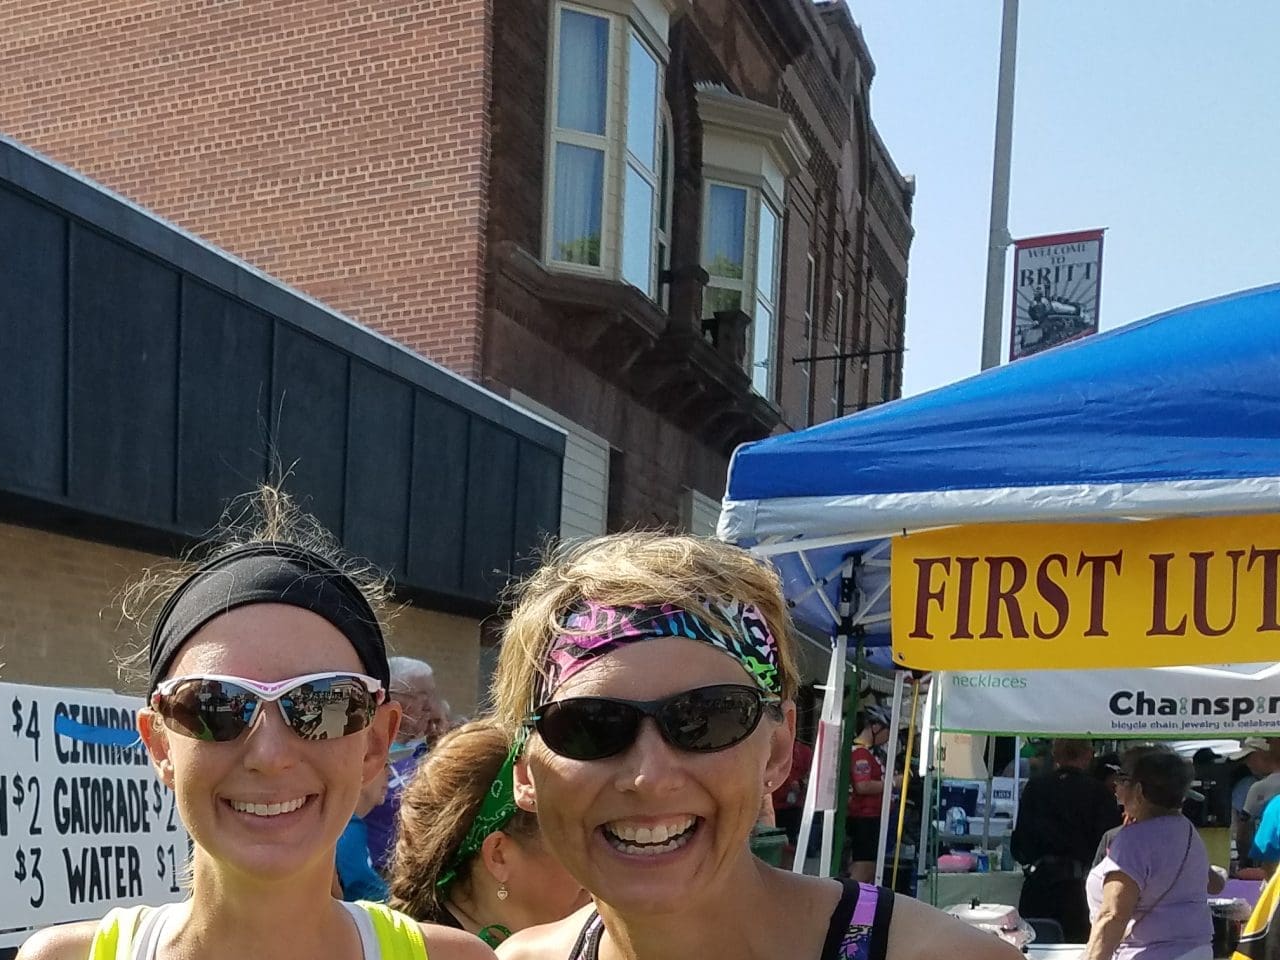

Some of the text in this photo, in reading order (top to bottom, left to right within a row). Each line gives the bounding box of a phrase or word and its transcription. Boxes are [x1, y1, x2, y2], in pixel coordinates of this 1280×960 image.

[1020, 261, 1098, 287] BRITT
[908, 544, 1280, 640] FIRST LUT
[952, 674, 1028, 689] necklaces
[12, 696, 40, 762] $4
[1150, 720, 1178, 729] chain
[12, 772, 42, 836] $2
[53, 776, 151, 835] GATORADE
[14, 845, 45, 908] $3
[62, 846, 143, 904] WATER
[157, 845, 180, 893] $1
